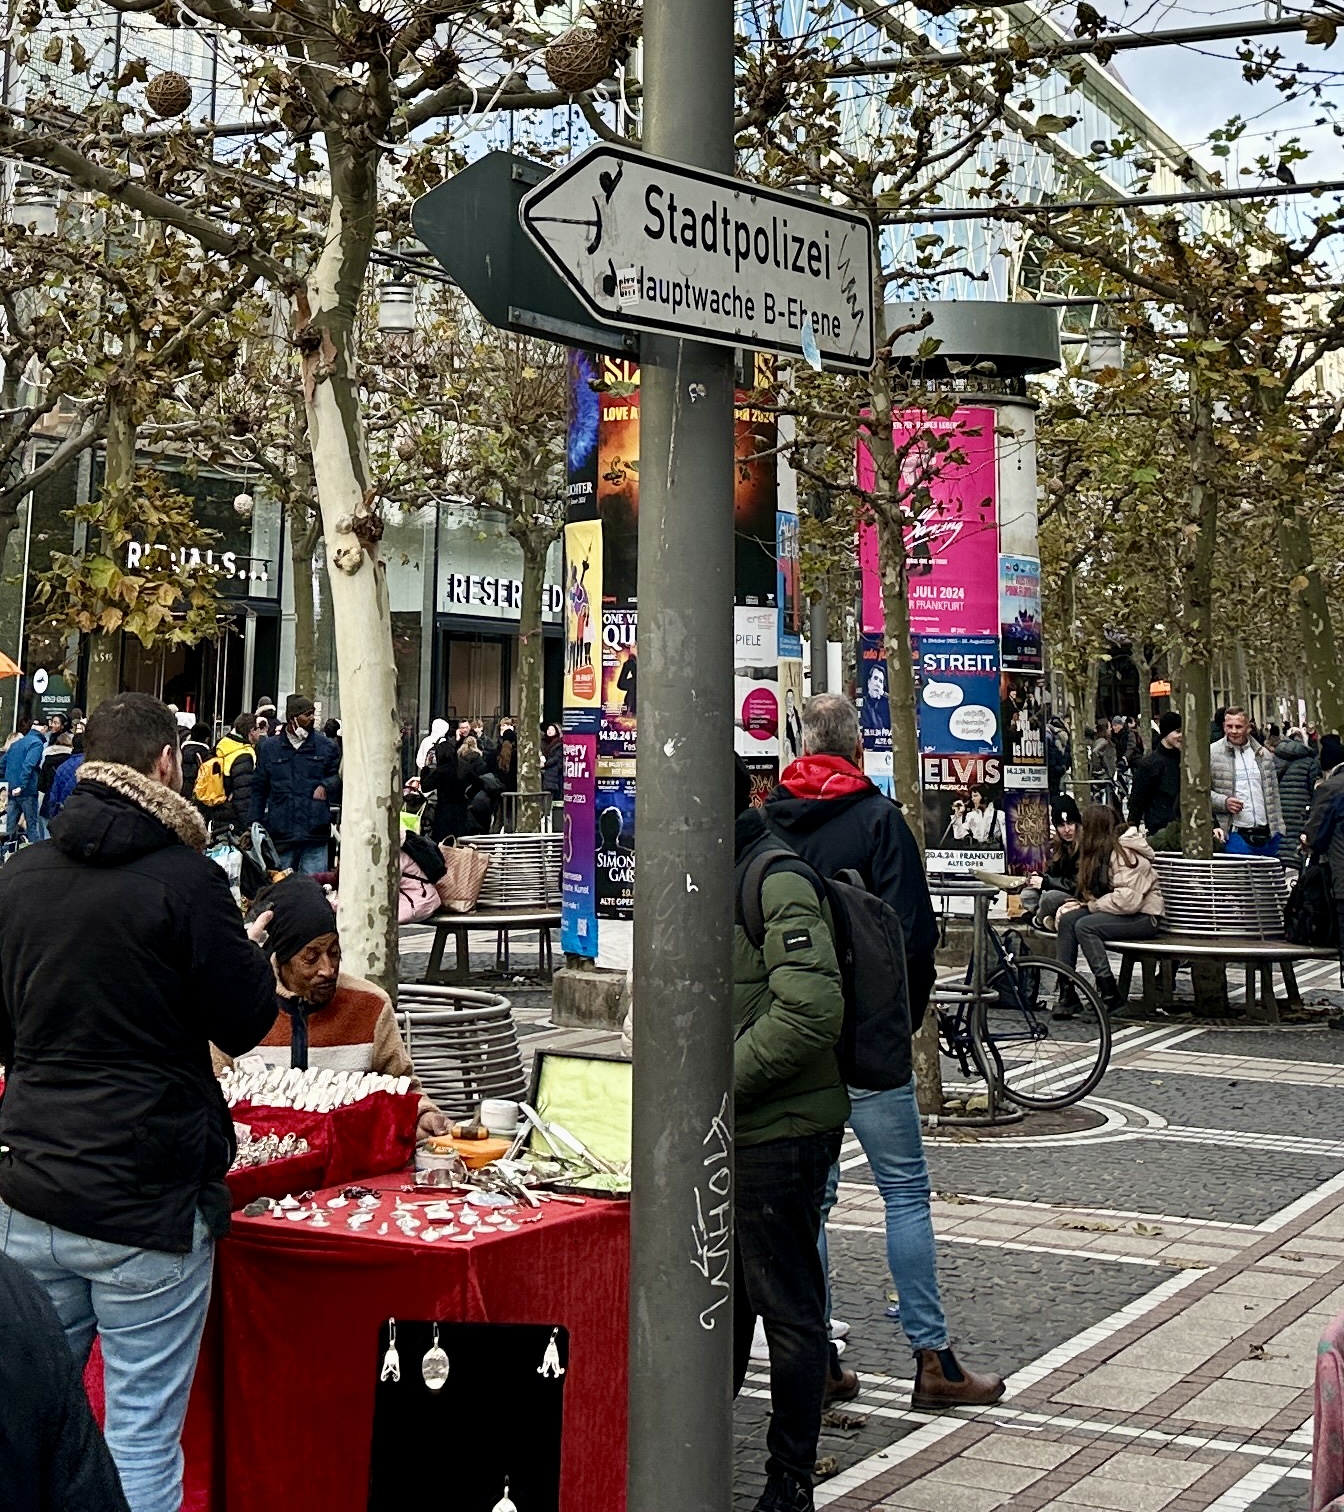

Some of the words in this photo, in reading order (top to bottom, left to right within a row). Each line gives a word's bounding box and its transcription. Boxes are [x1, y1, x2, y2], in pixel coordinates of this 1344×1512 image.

[643, 183, 831, 280] Stadtpolizei
[603, 406, 629, 422] LOVE
[452, 573, 564, 613] RESERED
[913, 586, 937, 599] JULI
[940, 586, 965, 600] 2024
[915, 599, 965, 612] FRANKFURT
[602, 613, 624, 625] ONE
[923, 653, 997, 672] STREIT.
[924, 757, 1001, 784] ELVIS
[597, 853, 636, 868] SIMON
[959, 852, 1004, 860] FRANKFURT
[600, 898, 615, 906] ALTE
